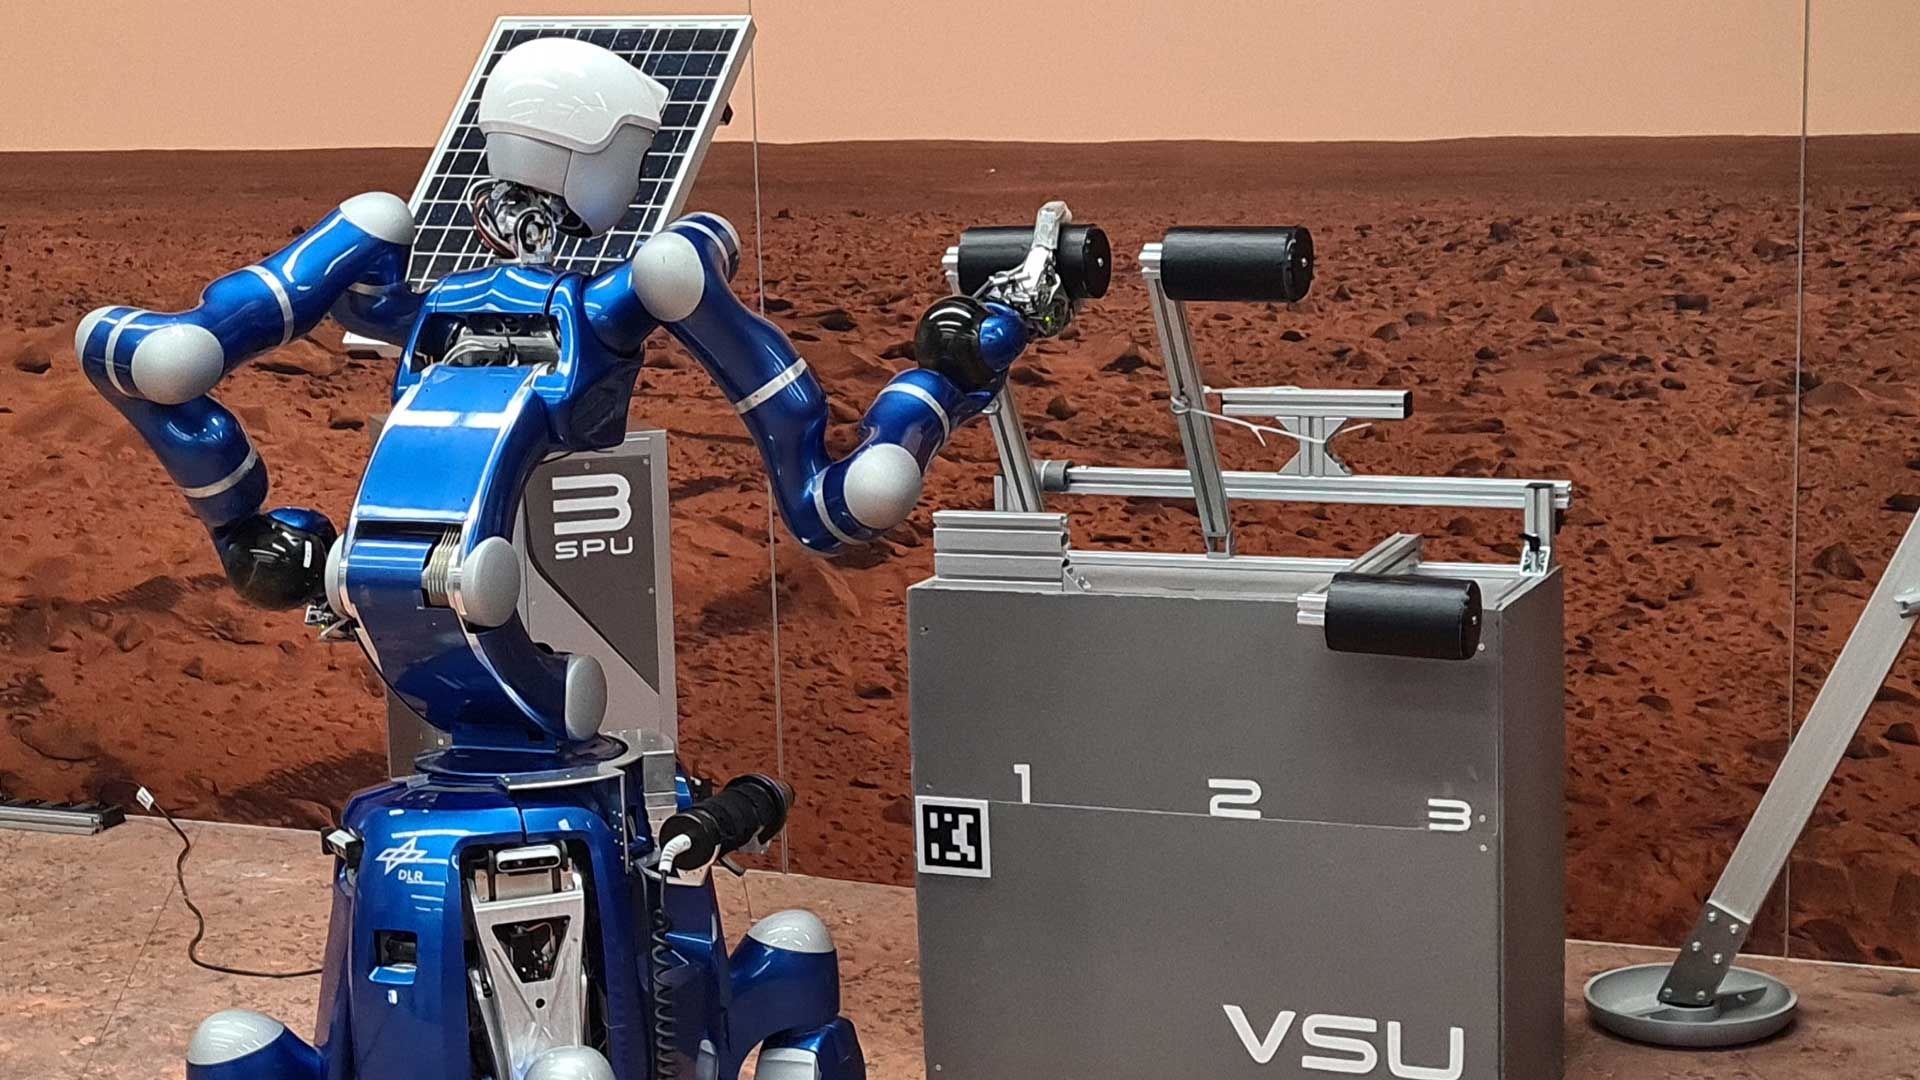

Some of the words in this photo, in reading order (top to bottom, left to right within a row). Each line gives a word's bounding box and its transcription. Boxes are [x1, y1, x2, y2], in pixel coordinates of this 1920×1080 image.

[552, 473, 632, 535] 3
[555, 536, 633, 560] SPU
[1013, 763, 1031, 804] 1
[1207, 778, 1262, 820] 2
[1427, 798, 1472, 832] 3
[398, 868, 424, 883] DLR
[1222, 1004, 1464, 1080] VSU
